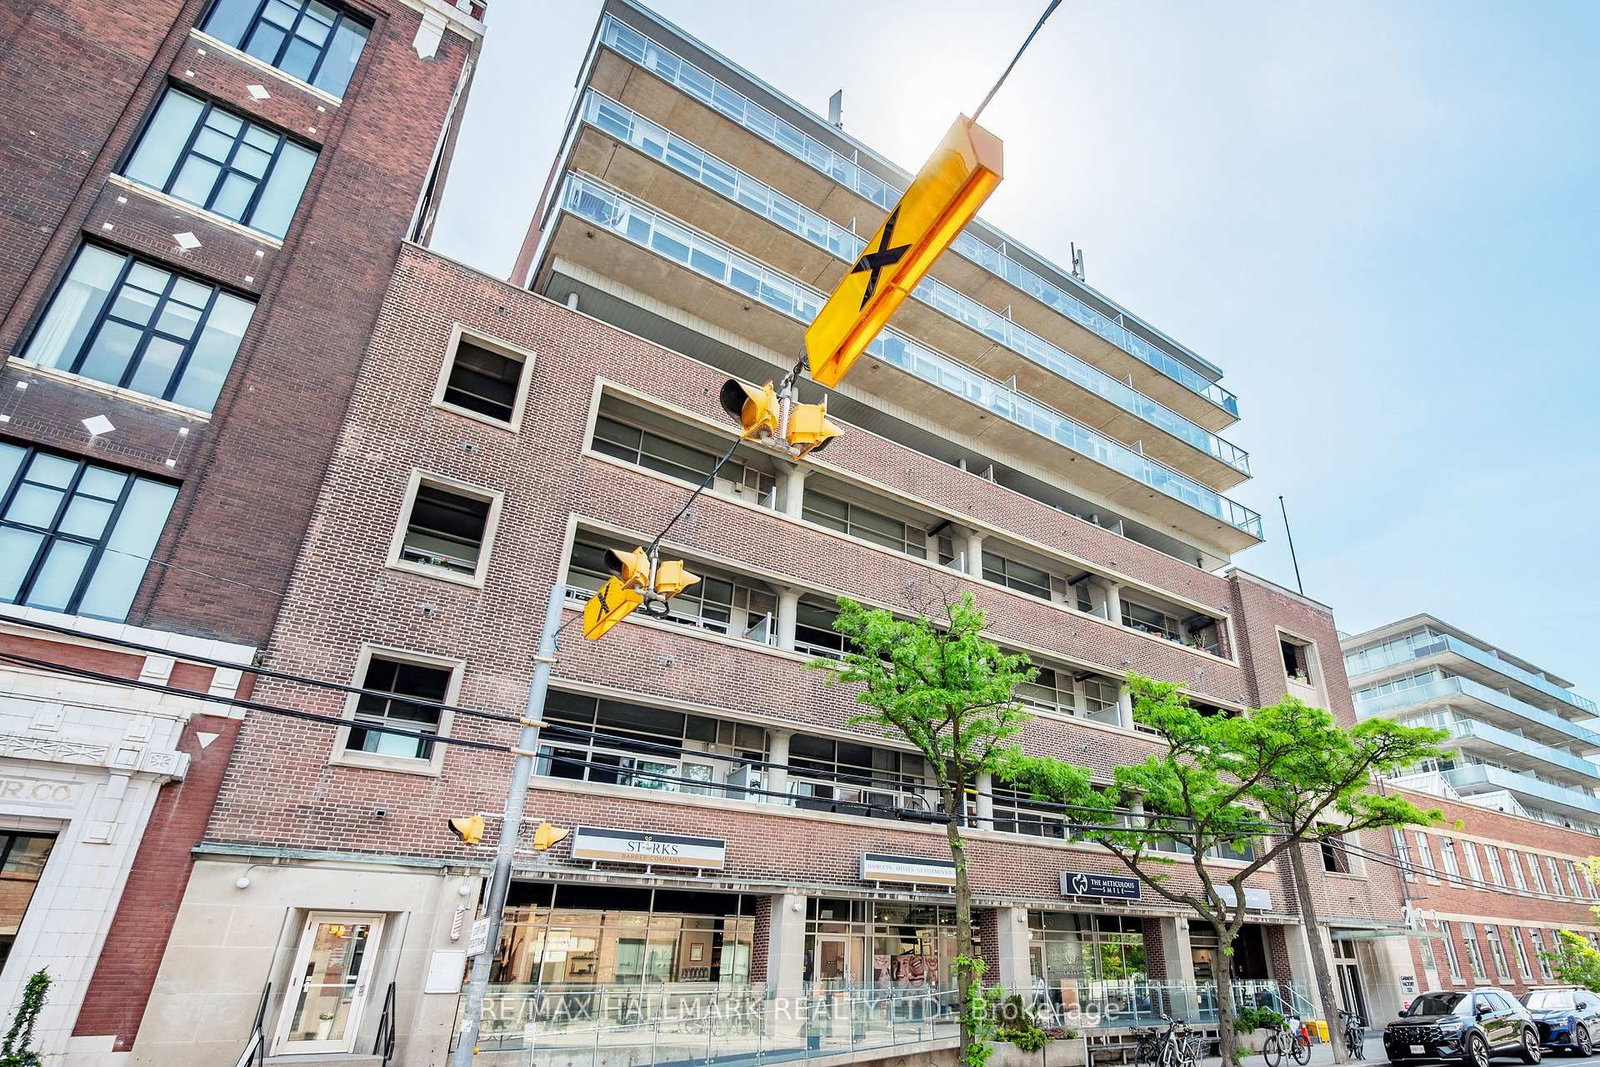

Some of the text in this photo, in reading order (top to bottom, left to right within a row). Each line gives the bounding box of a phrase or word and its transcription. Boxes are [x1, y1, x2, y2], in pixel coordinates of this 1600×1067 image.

[649, 855, 681, 863] COMPANY
[1102, 880, 1134, 888] METICULOUS
[1102, 887, 1125, 895] SMILE
[1401, 906, 1439, 929] 233
